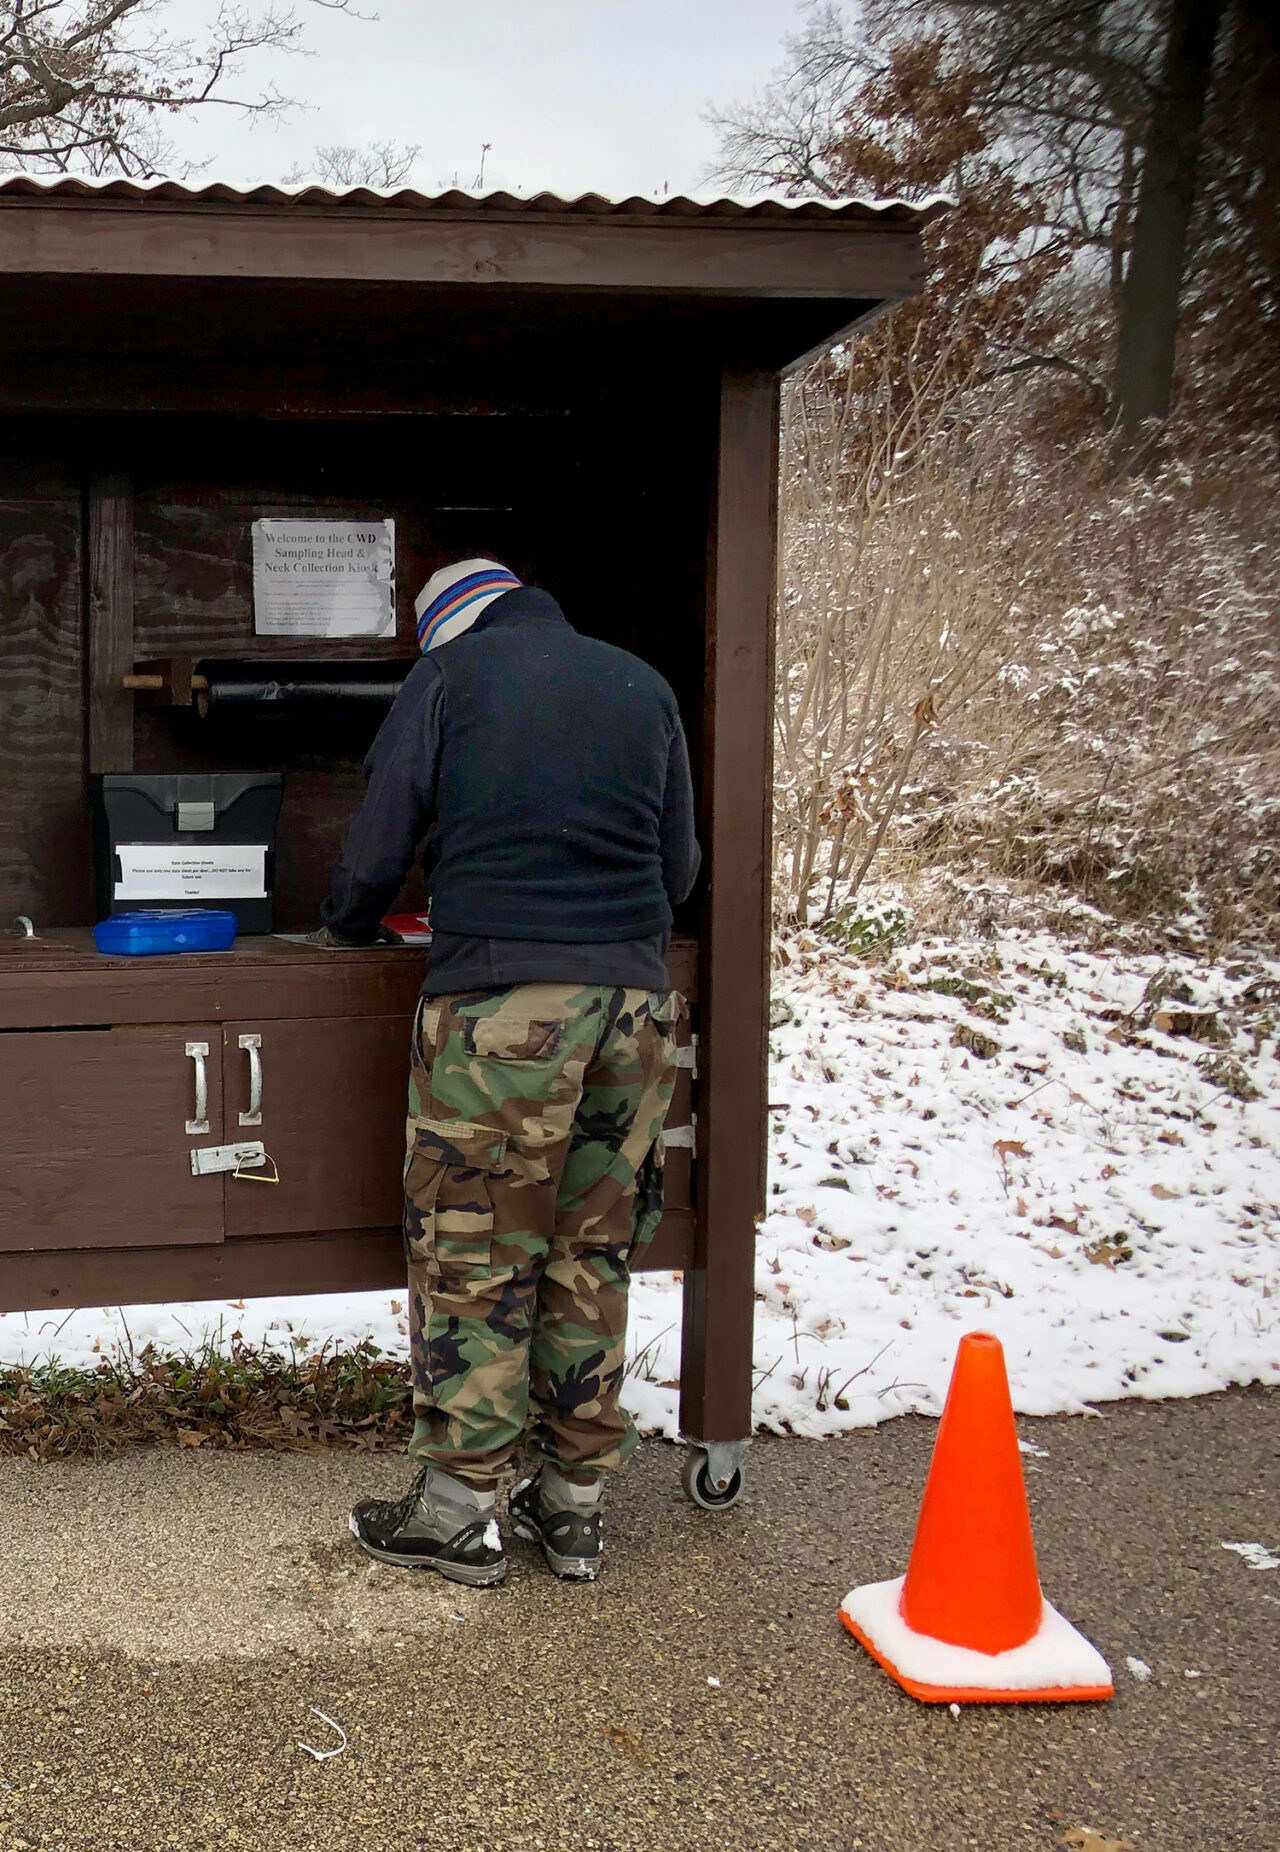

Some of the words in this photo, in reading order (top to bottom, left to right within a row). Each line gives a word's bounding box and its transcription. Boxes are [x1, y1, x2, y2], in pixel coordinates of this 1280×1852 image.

[265, 533, 313, 544] Welcome
[315, 534, 326, 544] to
[328, 533, 345, 544] the
[347, 534, 376, 544] CWD
[274, 548, 324, 560] Sampling
[326, 548, 354, 558] Head
[356, 549, 366, 558] &
[264, 562, 290, 572] Neck
[293, 562, 344, 573] Collection
[348, 562, 379, 573] Kiosk
[452, 1530, 475, 1549] SCARPA
